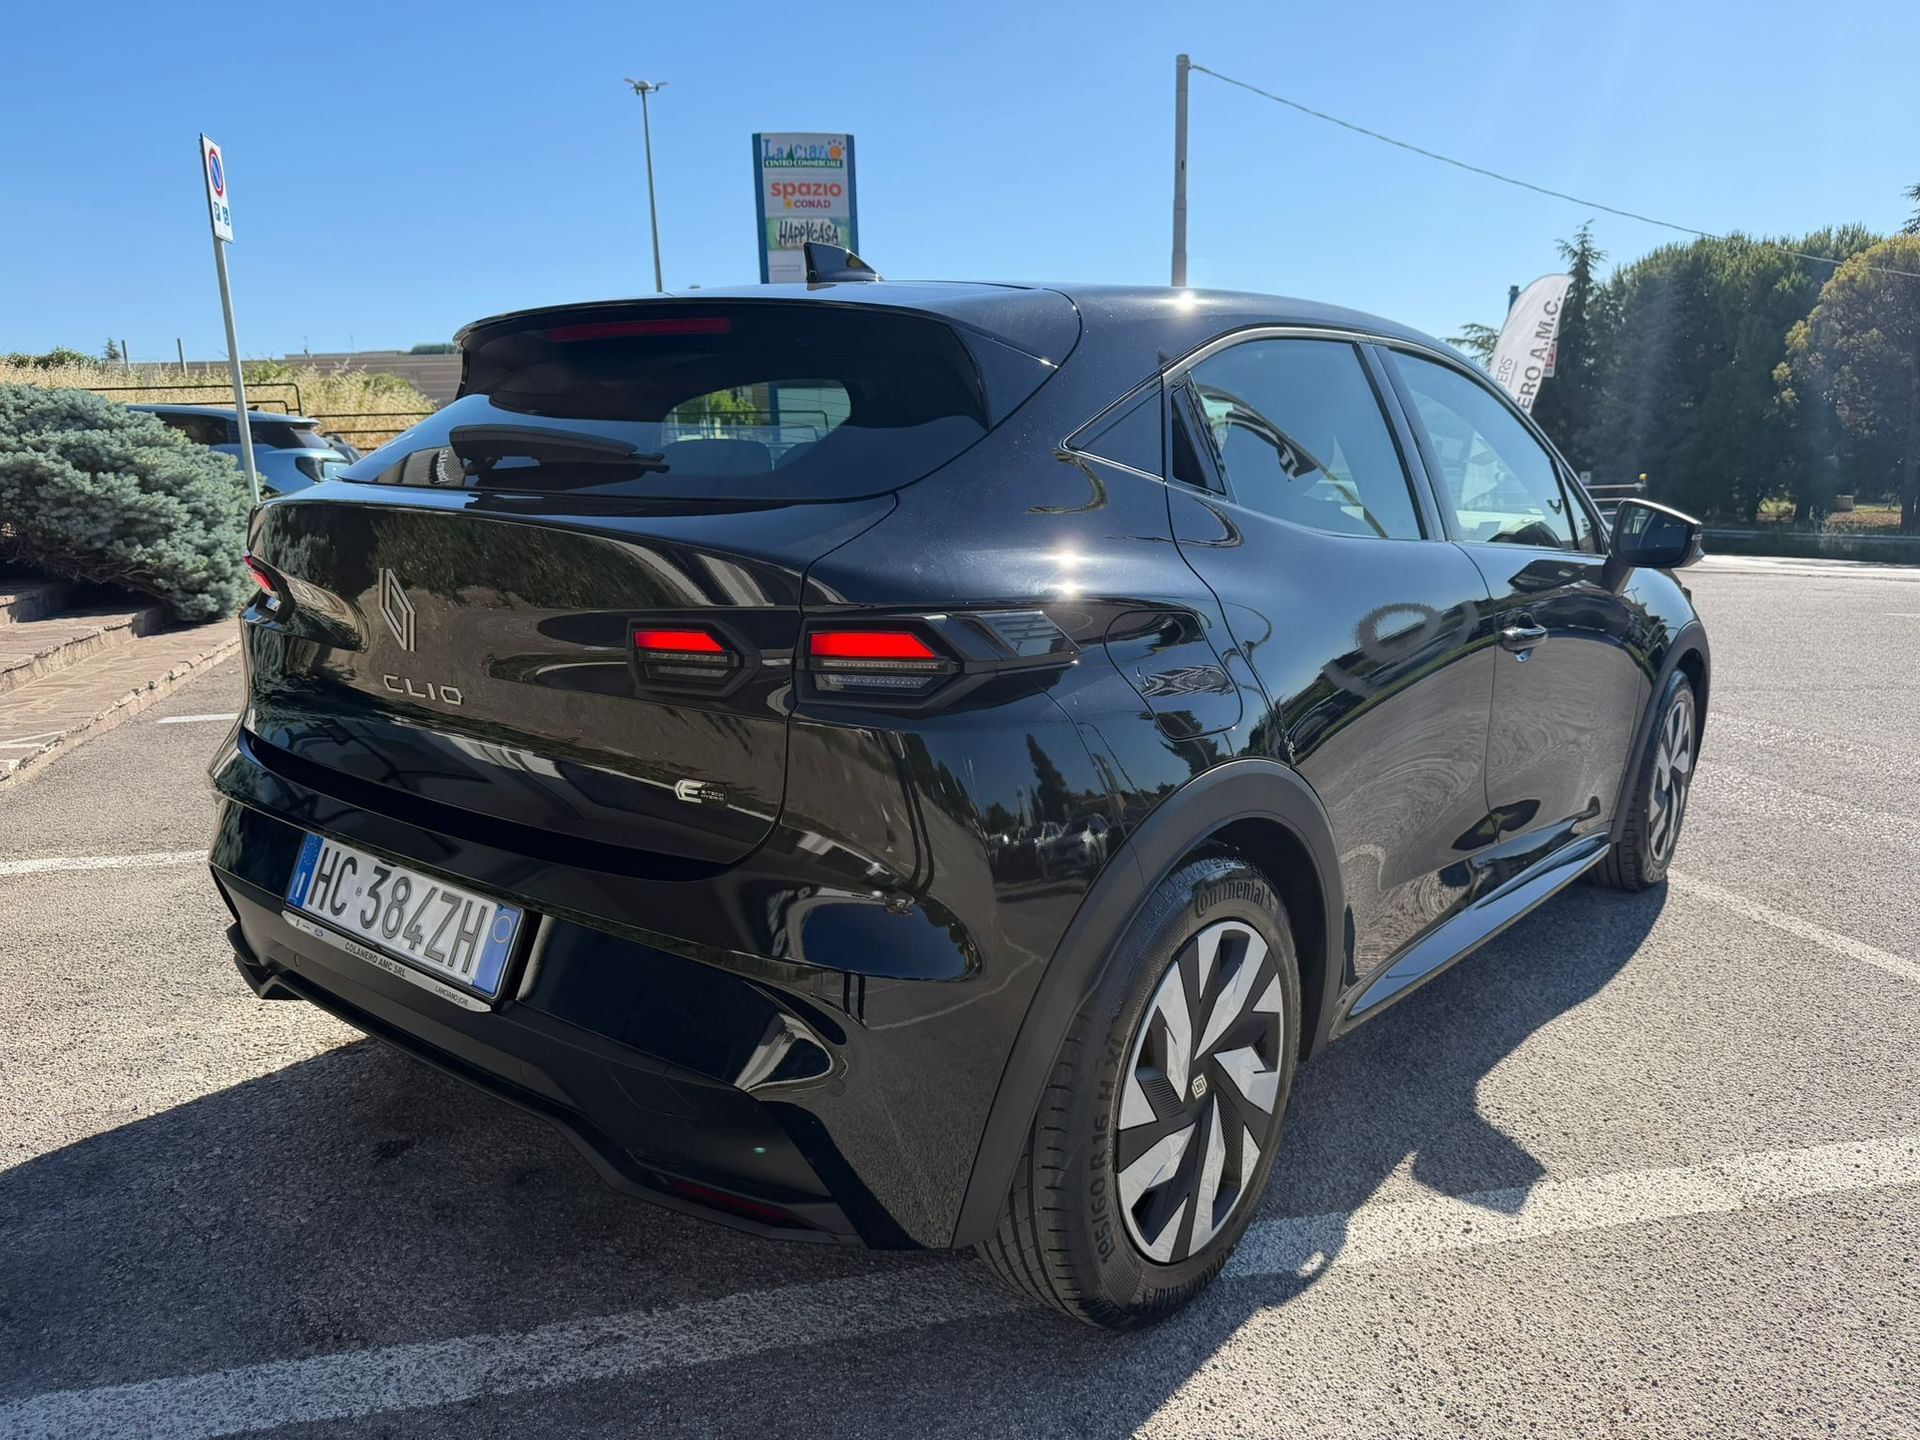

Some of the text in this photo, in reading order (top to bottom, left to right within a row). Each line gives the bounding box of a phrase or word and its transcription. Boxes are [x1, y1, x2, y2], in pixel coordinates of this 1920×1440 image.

[771, 182, 842, 200] spazio
[794, 200, 831, 208] CONAD
[1530, 297, 1561, 360] A.M.C.
[383, 674, 463, 706] CLIO
[295, 872, 306, 898] I
[1194, 880, 1265, 919] Continental
[307, 847, 487, 974] HC 384ZH
[344, 942, 406, 978] COLANERO AMC SRL
[435, 985, 459, 1001] LANCIANO
